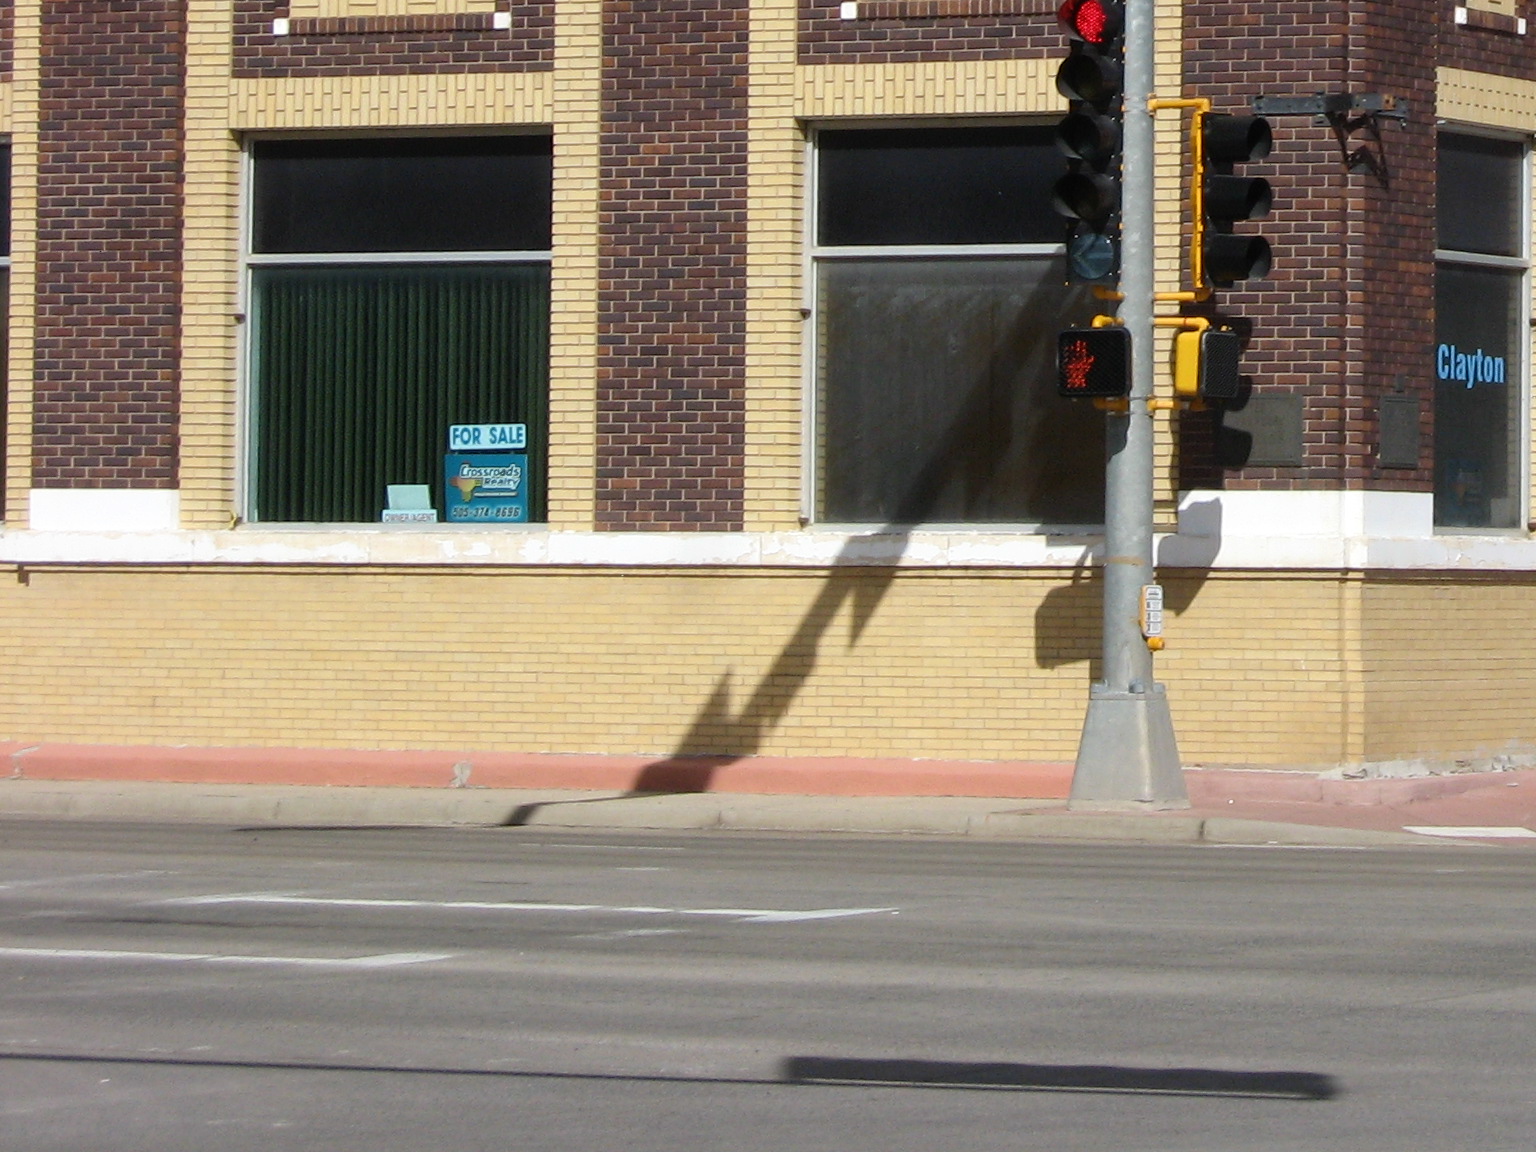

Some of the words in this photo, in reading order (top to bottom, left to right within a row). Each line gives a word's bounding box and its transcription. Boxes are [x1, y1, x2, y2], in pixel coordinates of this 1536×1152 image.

[1437, 343, 1504, 389] Clayton
[452, 427, 481, 445] FOR
[489, 426, 524, 445] SALE
[460, 463, 521, 478] Crossroads
[483, 477, 521, 489] Realty
